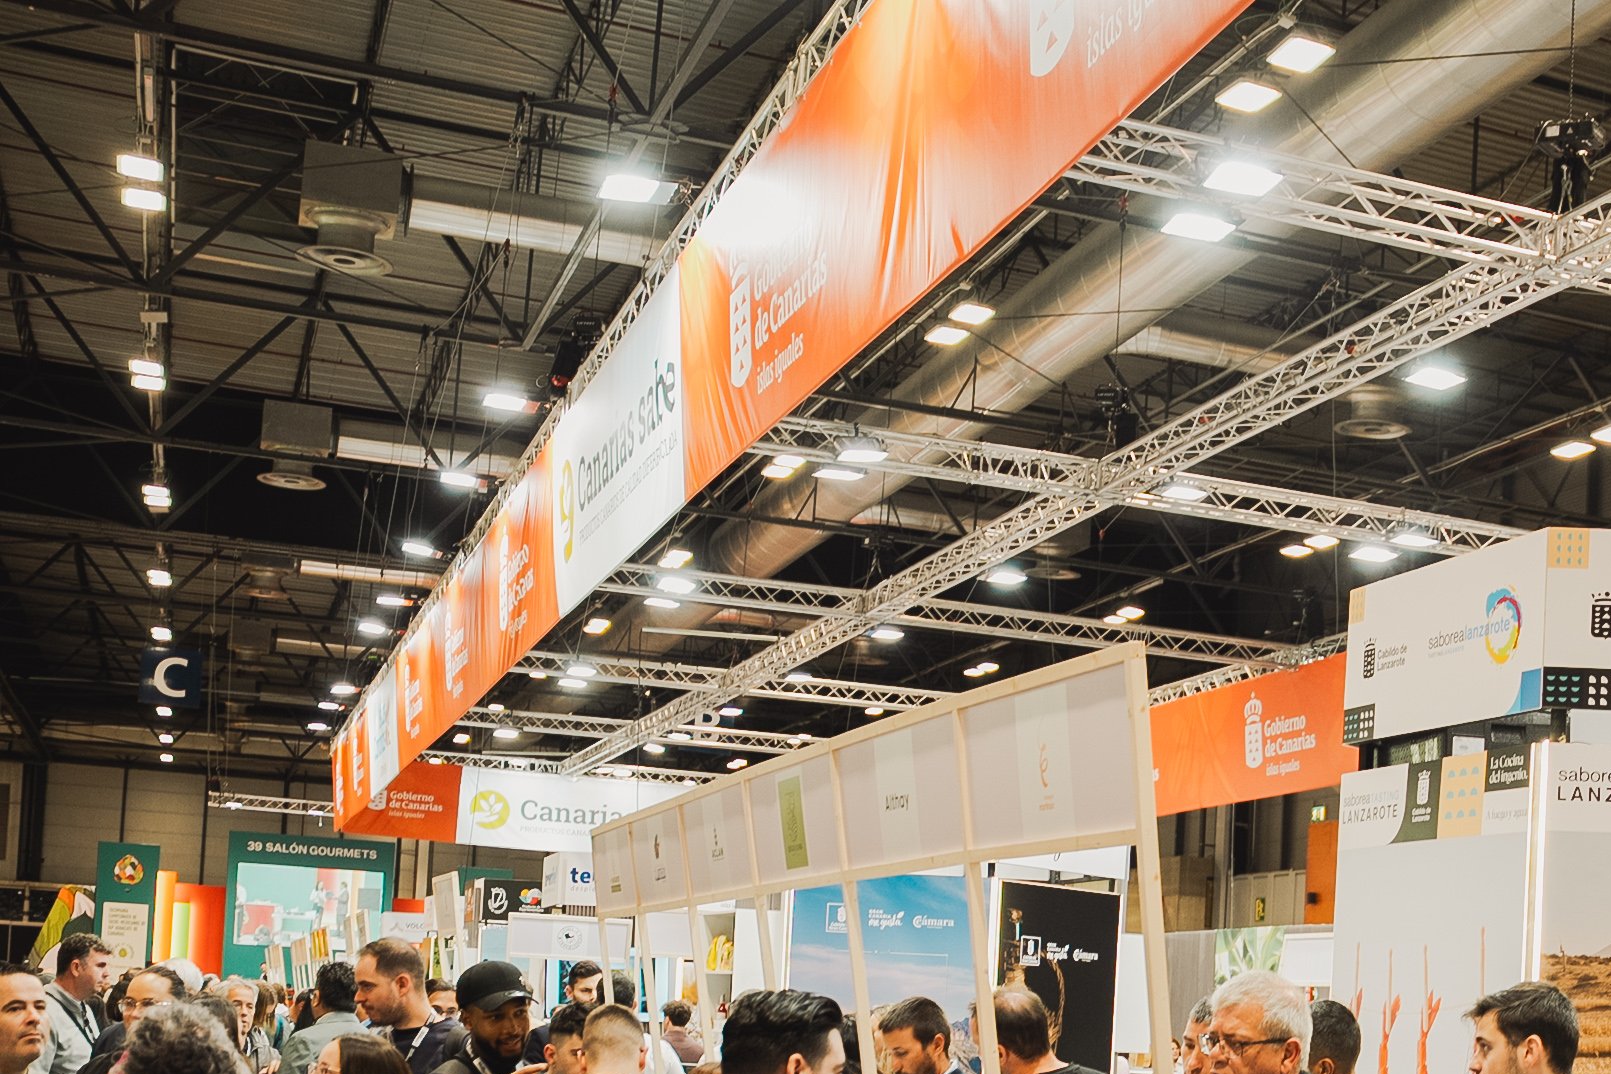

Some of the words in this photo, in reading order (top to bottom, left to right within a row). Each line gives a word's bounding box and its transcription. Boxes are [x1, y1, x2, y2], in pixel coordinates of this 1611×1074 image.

[754, 305, 769, 350] de
[769, 251, 827, 334] Canarias
[757, 360, 774, 395] islas
[774, 331, 804, 384] iguales
[577, 410, 635, 512] Canarias
[154, 657, 189, 698] C
[1264, 714, 1306, 735] Gobierno
[1264, 743, 1276, 758] de
[1276, 733, 1316, 755] Canarias
[1490, 756, 1499, 769] La
[1500, 753, 1524, 769] Cocina
[389, 799, 401, 809] de
[401, 801, 443, 813] Canarias
[390, 790, 434, 803] Gobierno
[1342, 804, 1399, 825] LANZAROTE
[247, 840, 263, 852] 39
[265, 840, 308, 855] SALÓN
[309, 844, 378, 860] GOURMETS
[570, 867, 593, 884] te
